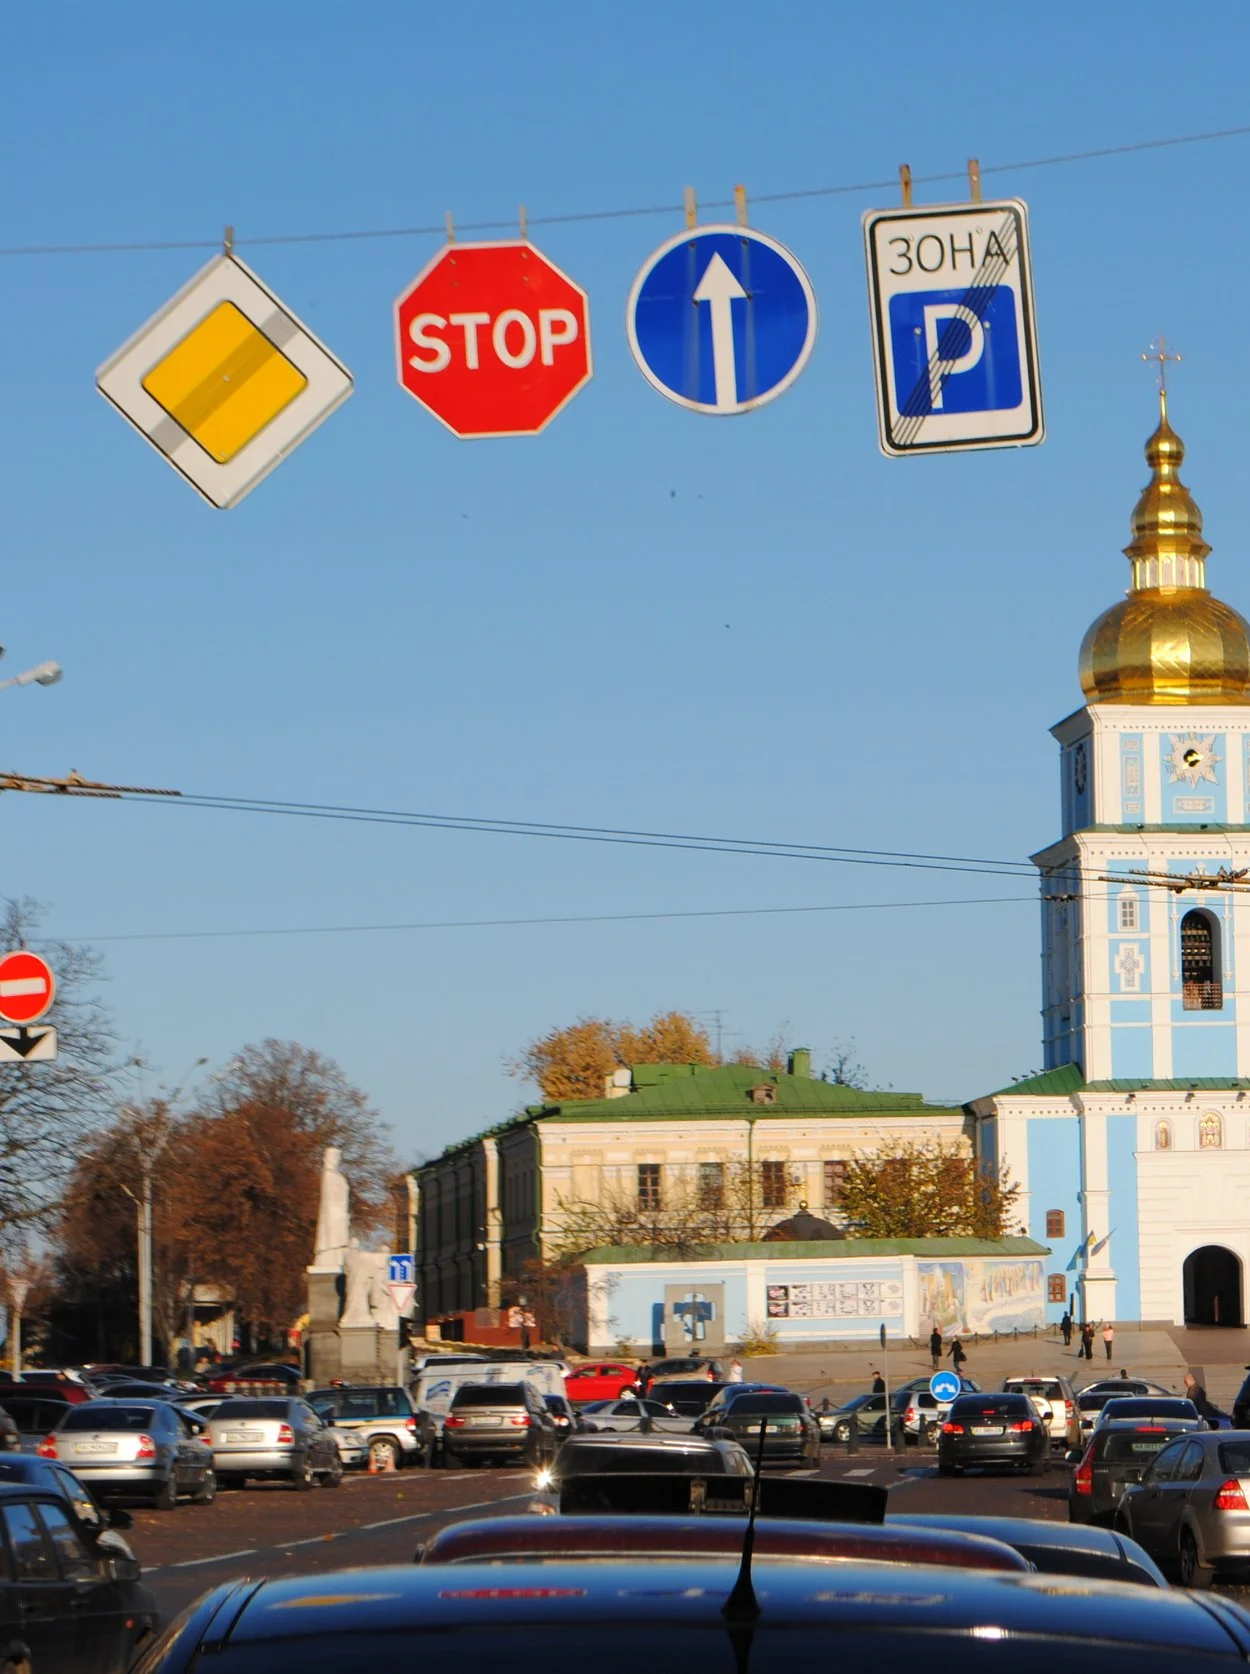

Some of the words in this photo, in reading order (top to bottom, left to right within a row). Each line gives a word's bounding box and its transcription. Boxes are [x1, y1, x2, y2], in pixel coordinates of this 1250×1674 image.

[888, 230, 1010, 275] ЗОНА
[408, 308, 579, 374] STOP
[923, 303, 985, 409] P
